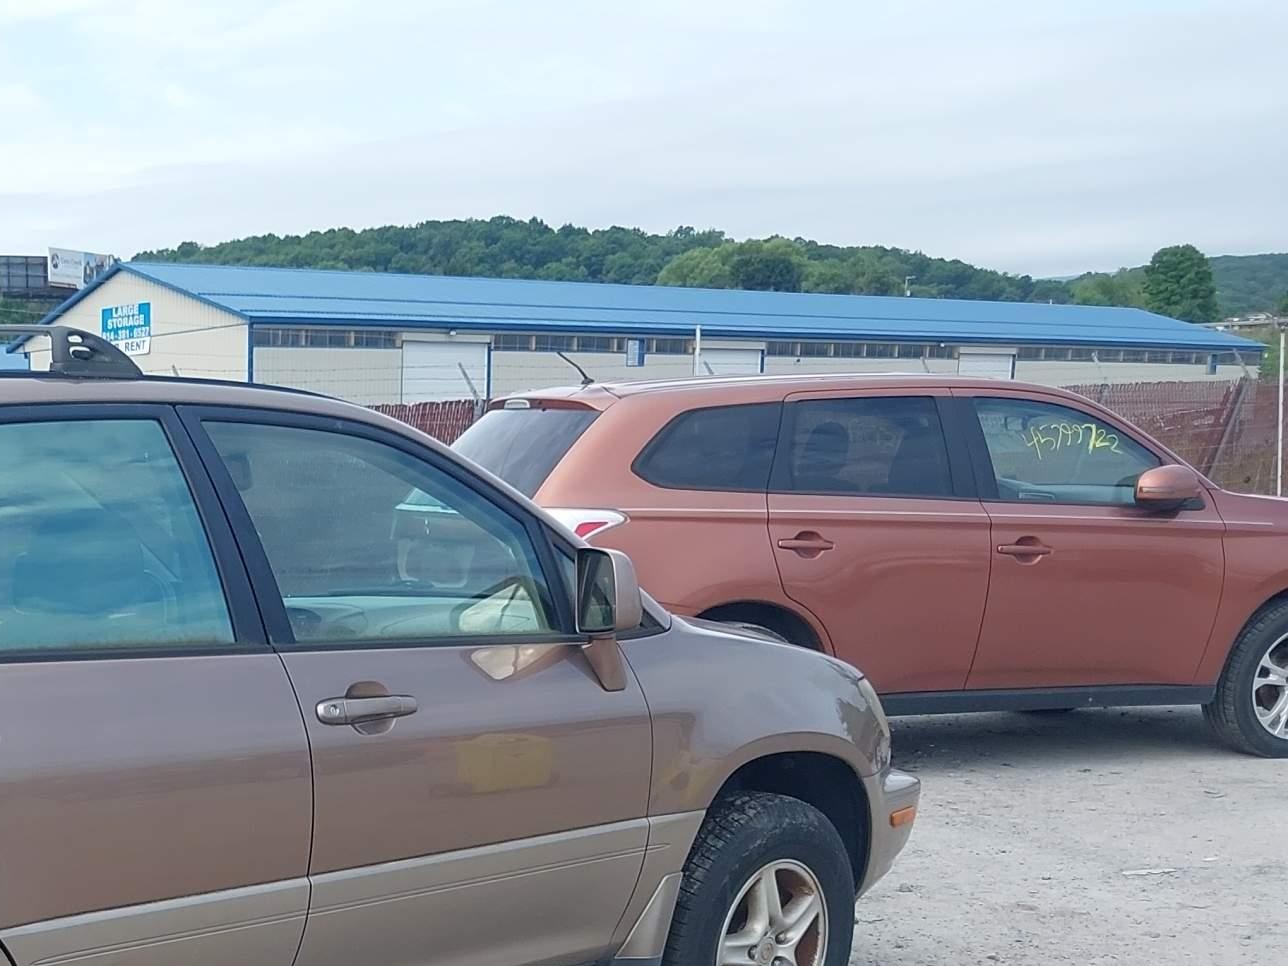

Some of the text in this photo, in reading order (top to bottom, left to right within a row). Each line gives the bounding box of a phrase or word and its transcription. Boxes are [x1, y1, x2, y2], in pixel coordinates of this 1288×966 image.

[112, 304, 139, 317] LARGE
[107, 314, 145, 329] STORAGE
[124, 340, 146, 353] RENT
